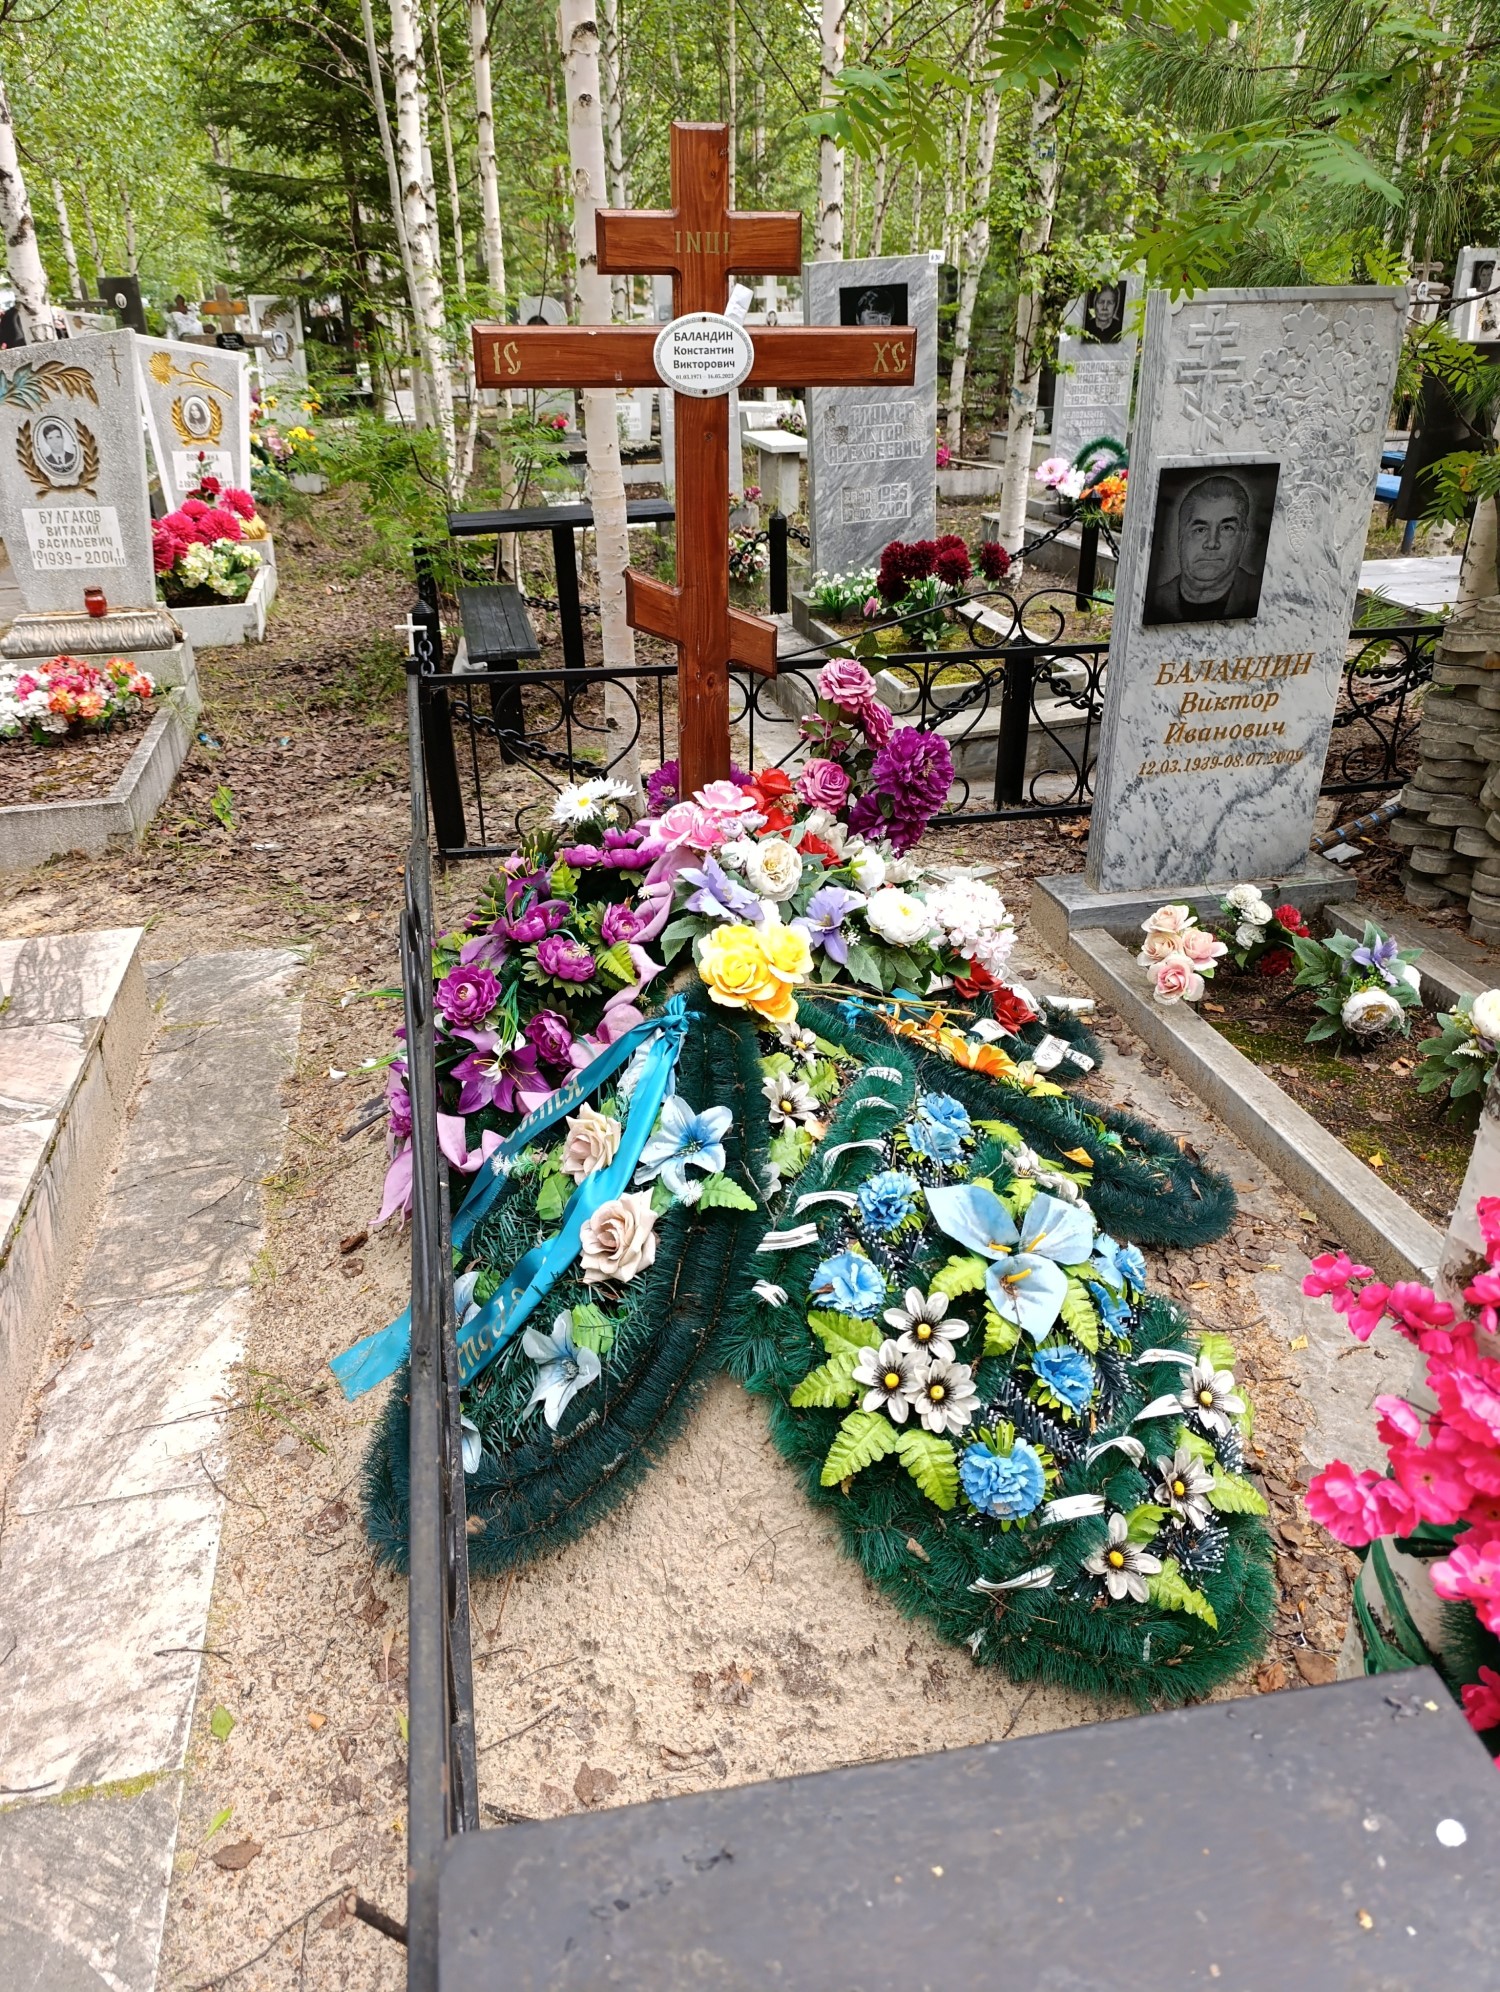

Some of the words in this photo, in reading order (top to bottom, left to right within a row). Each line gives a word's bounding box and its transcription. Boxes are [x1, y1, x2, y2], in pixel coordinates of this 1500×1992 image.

[674, 331, 733, 343] БАЛАНДИН
[673, 346, 734, 355] Константин
[673, 360, 735, 371] Викторович
[829, 440, 922, 463] АЛЕКСЕЕВИЧ
[878, 483, 908, 501] 1955
[38, 510, 102, 525] БУЛГАКОВ
[46, 522, 101, 537] ВИТАЛИЙ
[38, 537, 113, 549] ВАСИЛЬЕВИЧ
[44, 551, 73, 566] 1939
[84, 550, 114, 565] 2001
[1154, 652, 1316, 687] БАЛАНДИН
[1180, 691, 1280, 714] Виктор
[1163, 721, 1286, 745] Иванович
